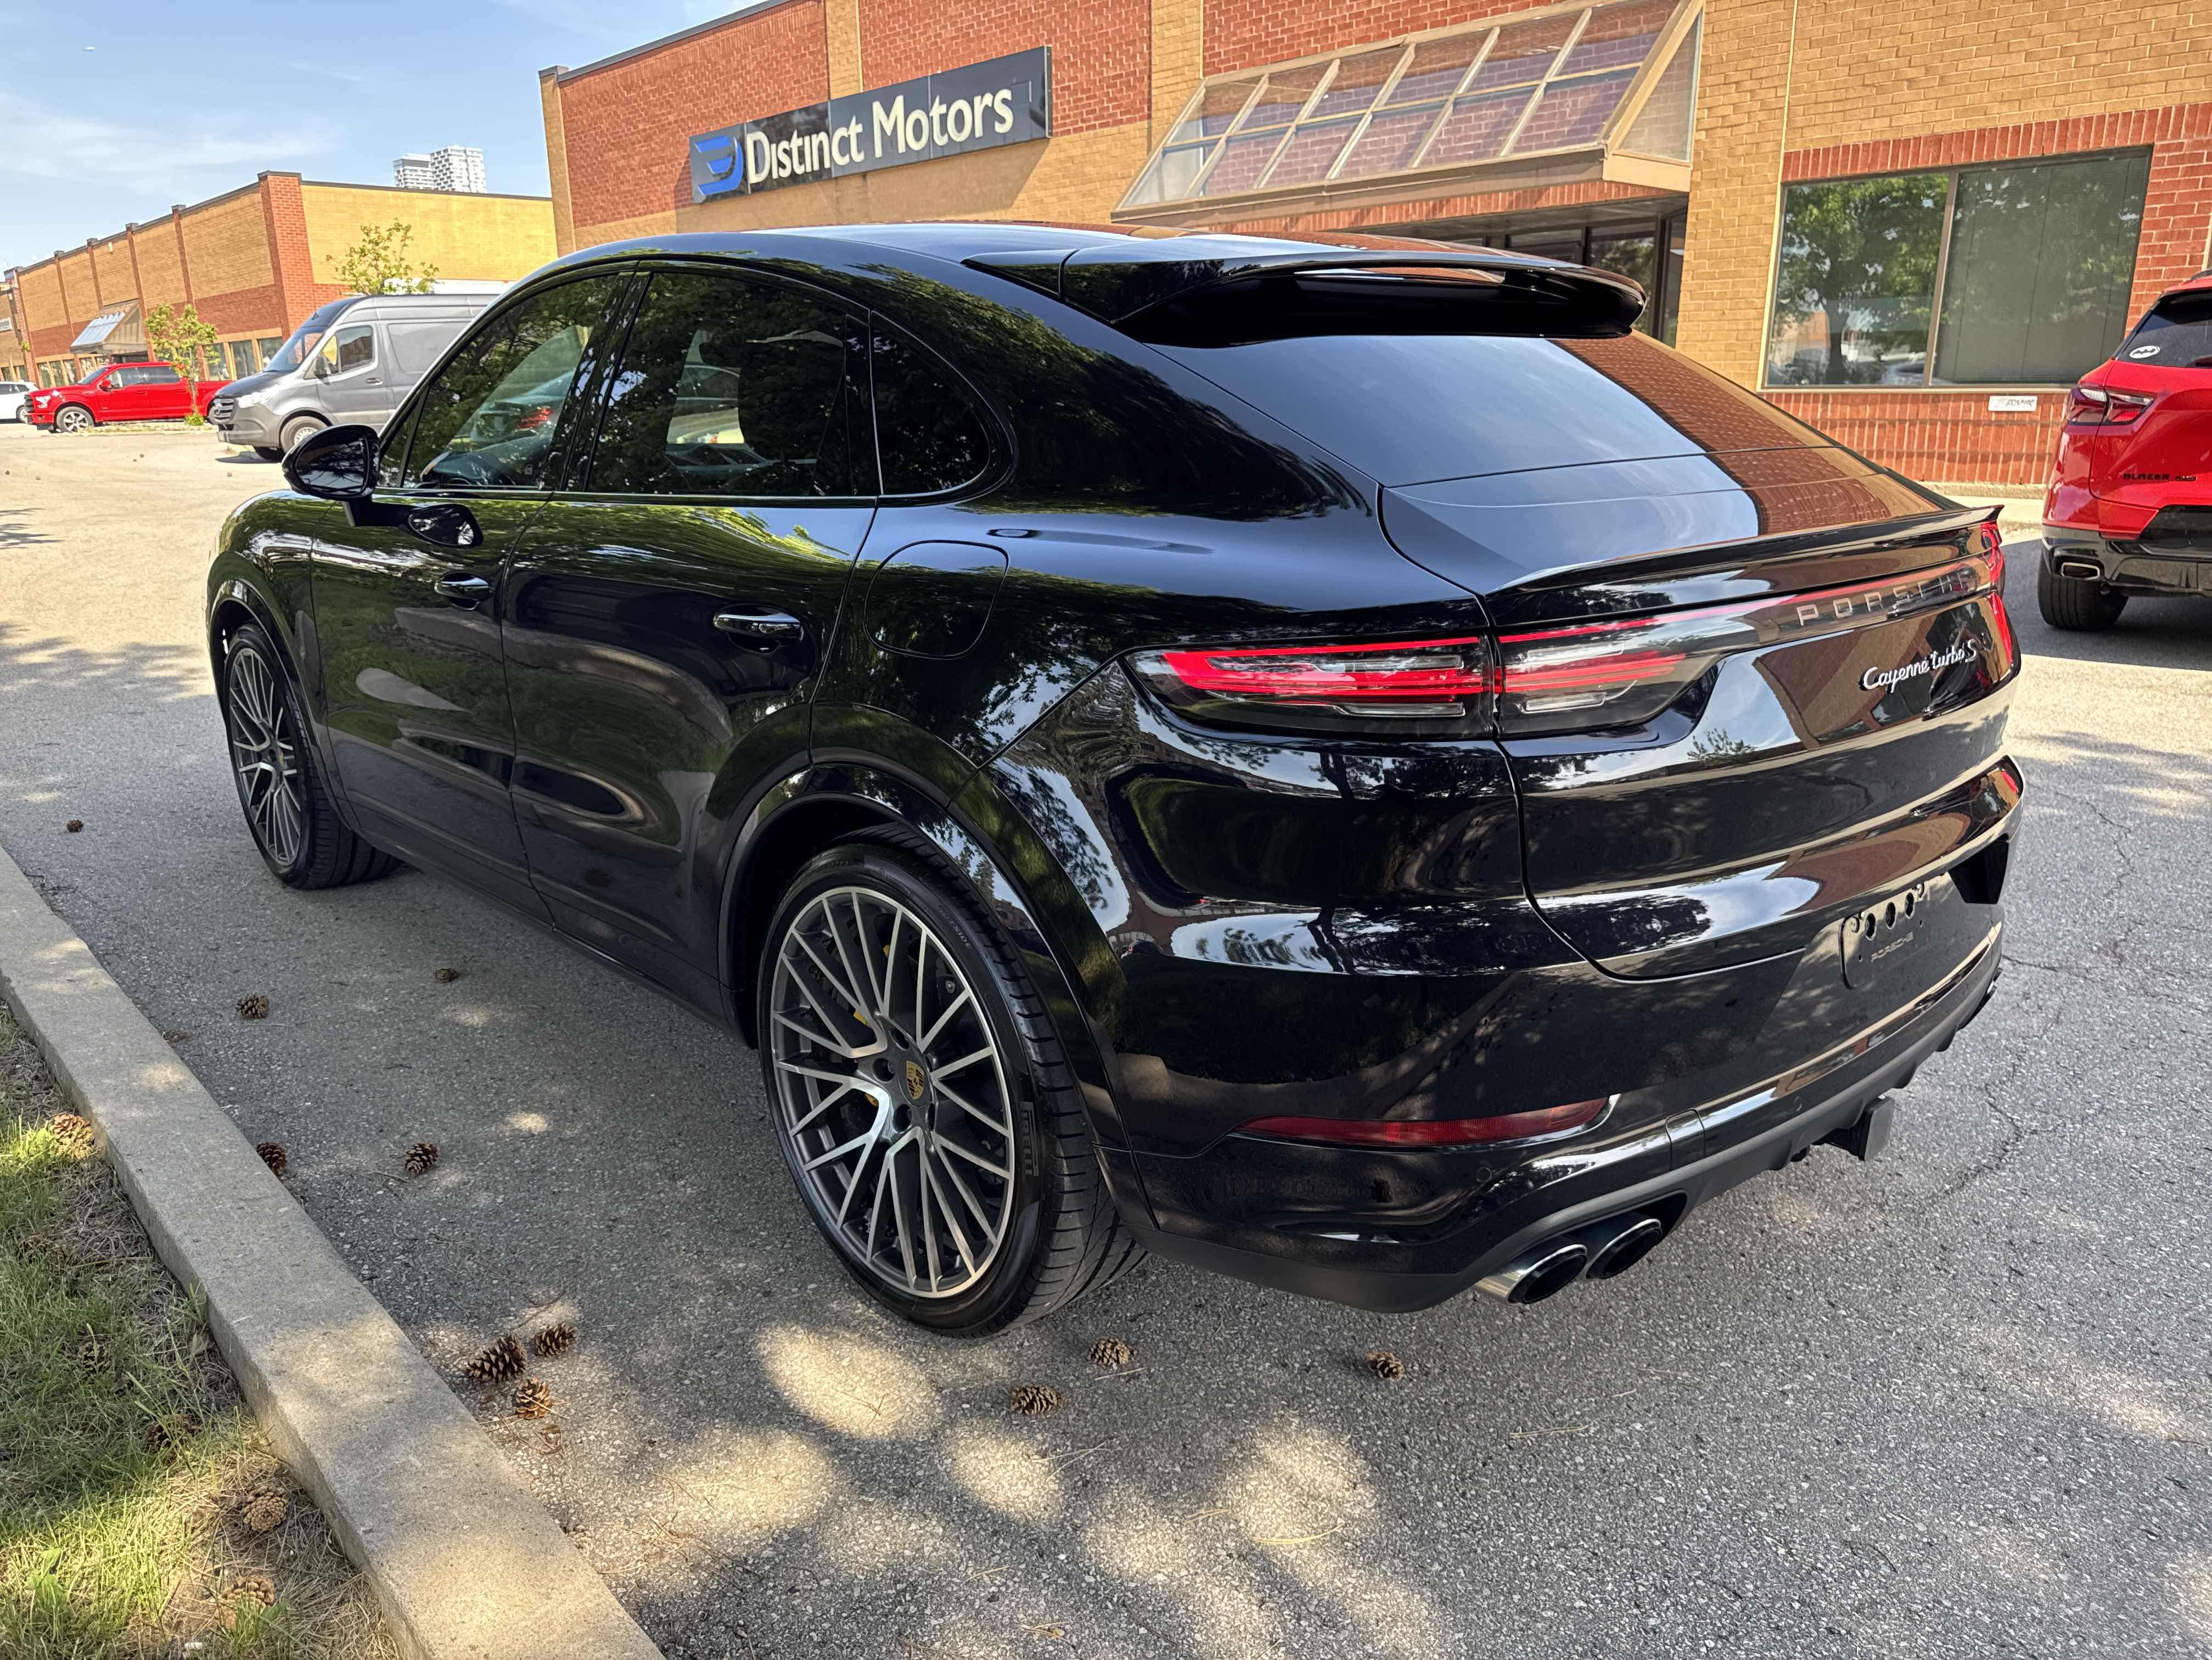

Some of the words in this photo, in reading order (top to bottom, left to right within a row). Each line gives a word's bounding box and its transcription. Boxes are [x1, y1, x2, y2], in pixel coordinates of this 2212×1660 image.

[745, 115, 865, 184] Distinct
[873, 88, 1015, 158] Motors
[1863, 659, 1930, 693] Cayenne
[1930, 643, 1964, 669] turbo
[1964, 638, 1978, 663] S
[937, 904, 974, 950] OUTSIDE
